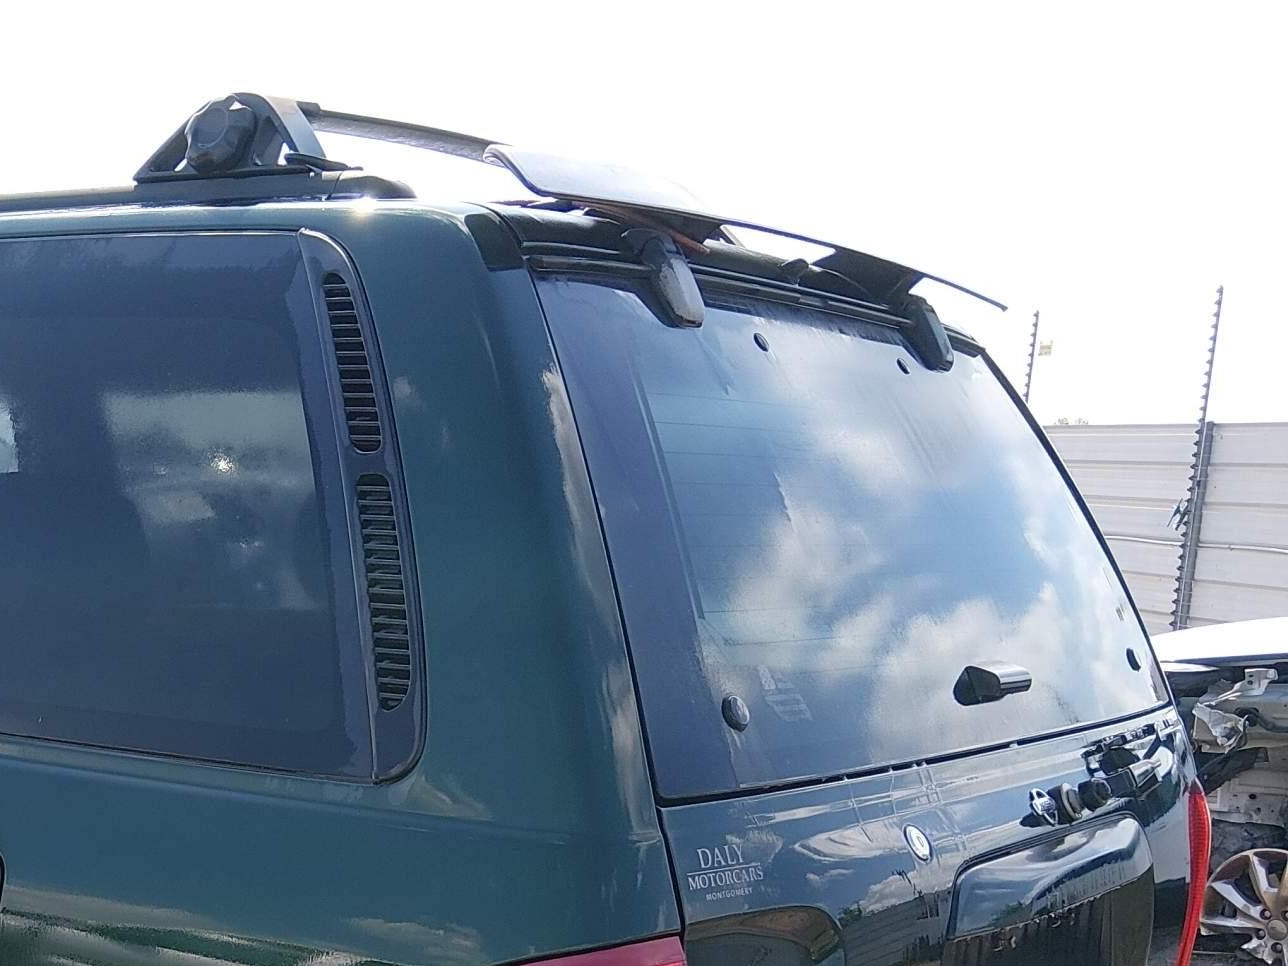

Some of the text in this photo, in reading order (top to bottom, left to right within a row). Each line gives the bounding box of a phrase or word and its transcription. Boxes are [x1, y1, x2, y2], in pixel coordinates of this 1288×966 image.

[696, 844, 744, 869] DALY
[688, 865, 764, 890] MOTORCARS
[705, 886, 753, 901] MONTGOMERY
